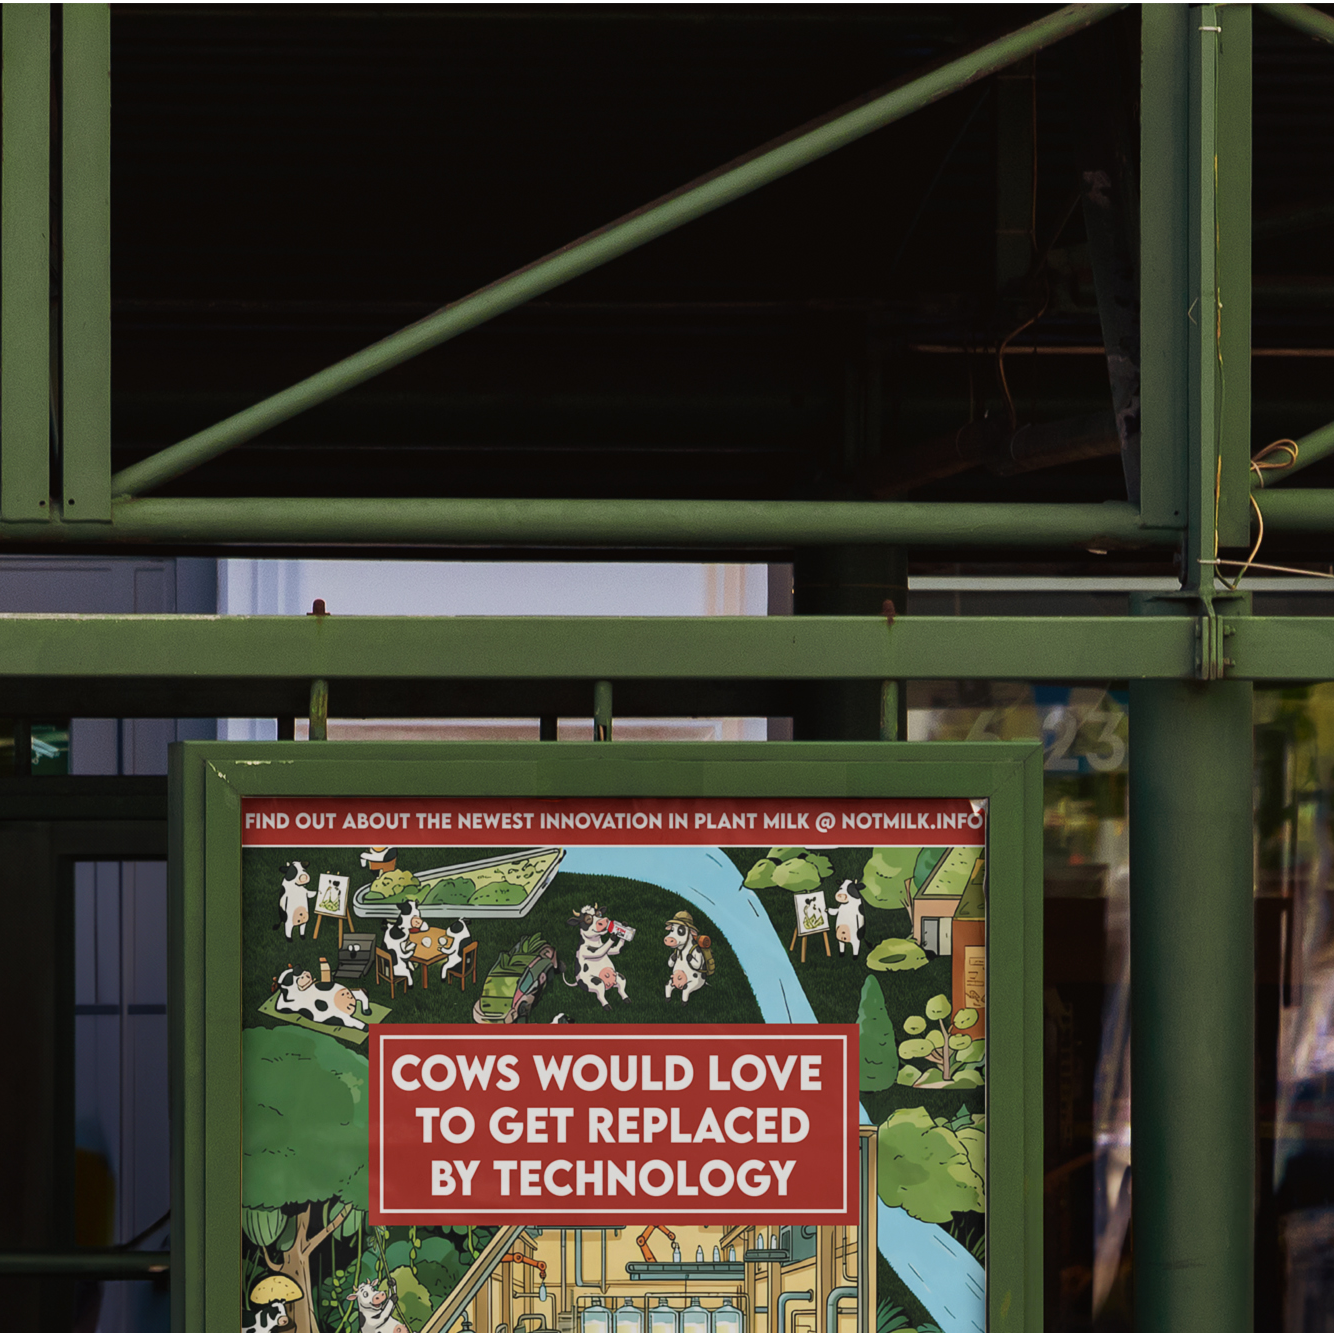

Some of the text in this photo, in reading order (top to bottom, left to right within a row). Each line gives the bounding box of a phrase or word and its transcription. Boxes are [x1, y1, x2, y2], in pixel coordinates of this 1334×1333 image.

[1042, 704, 1126, 772] 23
[245, 812, 984, 833] FIND OUT ABOUT THE NEWEST INNOVATION IN PLANT MILK @ NOTMILK.INFO
[392, 1055, 822, 1092] COWS WOULD LOVE
[416, 1107, 810, 1144] TO GET REPLACED
[431, 1160, 796, 1197] BY TECHNOLOGY
